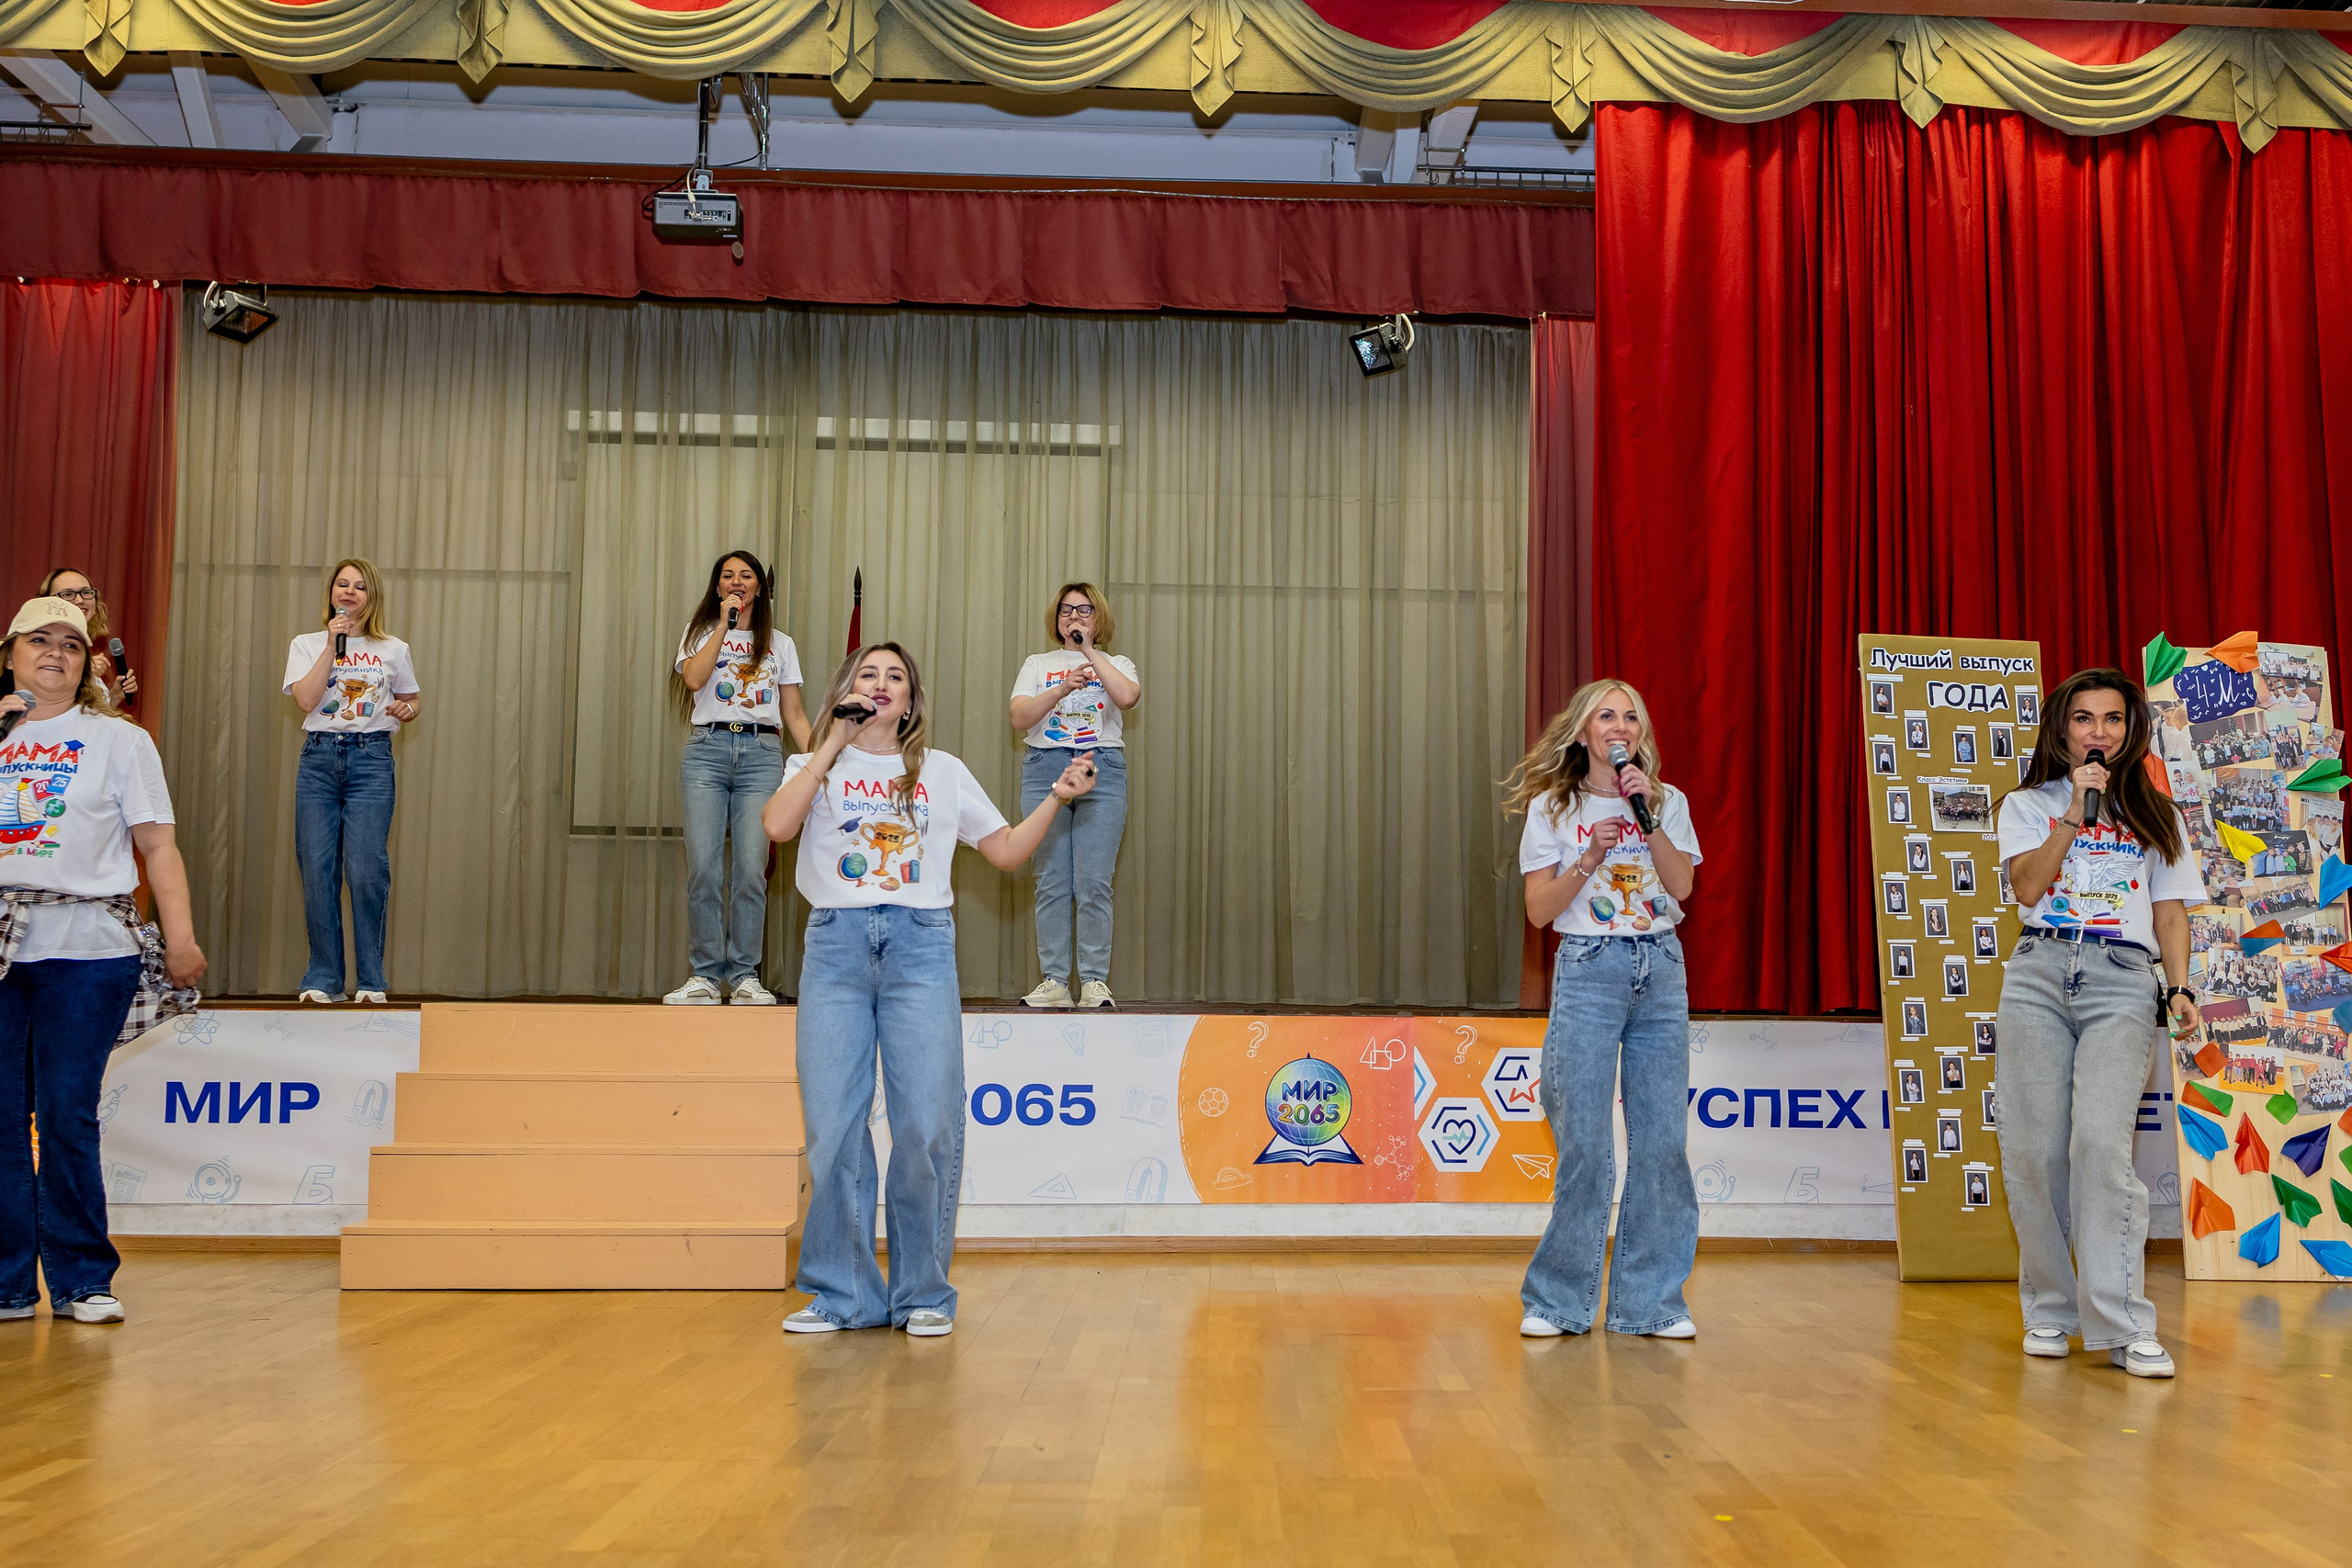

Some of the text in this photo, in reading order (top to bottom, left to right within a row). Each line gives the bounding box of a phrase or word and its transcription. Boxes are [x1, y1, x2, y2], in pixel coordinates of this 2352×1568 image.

[1871, 649, 2034, 676] Лучший выпуск
[1928, 682, 2009, 712] ГОДА
[54, 777, 67, 787] 25
[164, 1081, 321, 1124] МИР
[965, 1083, 1096, 1126] 065
[1282, 1080, 1338, 1101] МИР
[1278, 1103, 1340, 1125] 2065
[1688, 1087, 1867, 1129] СПЕХ
